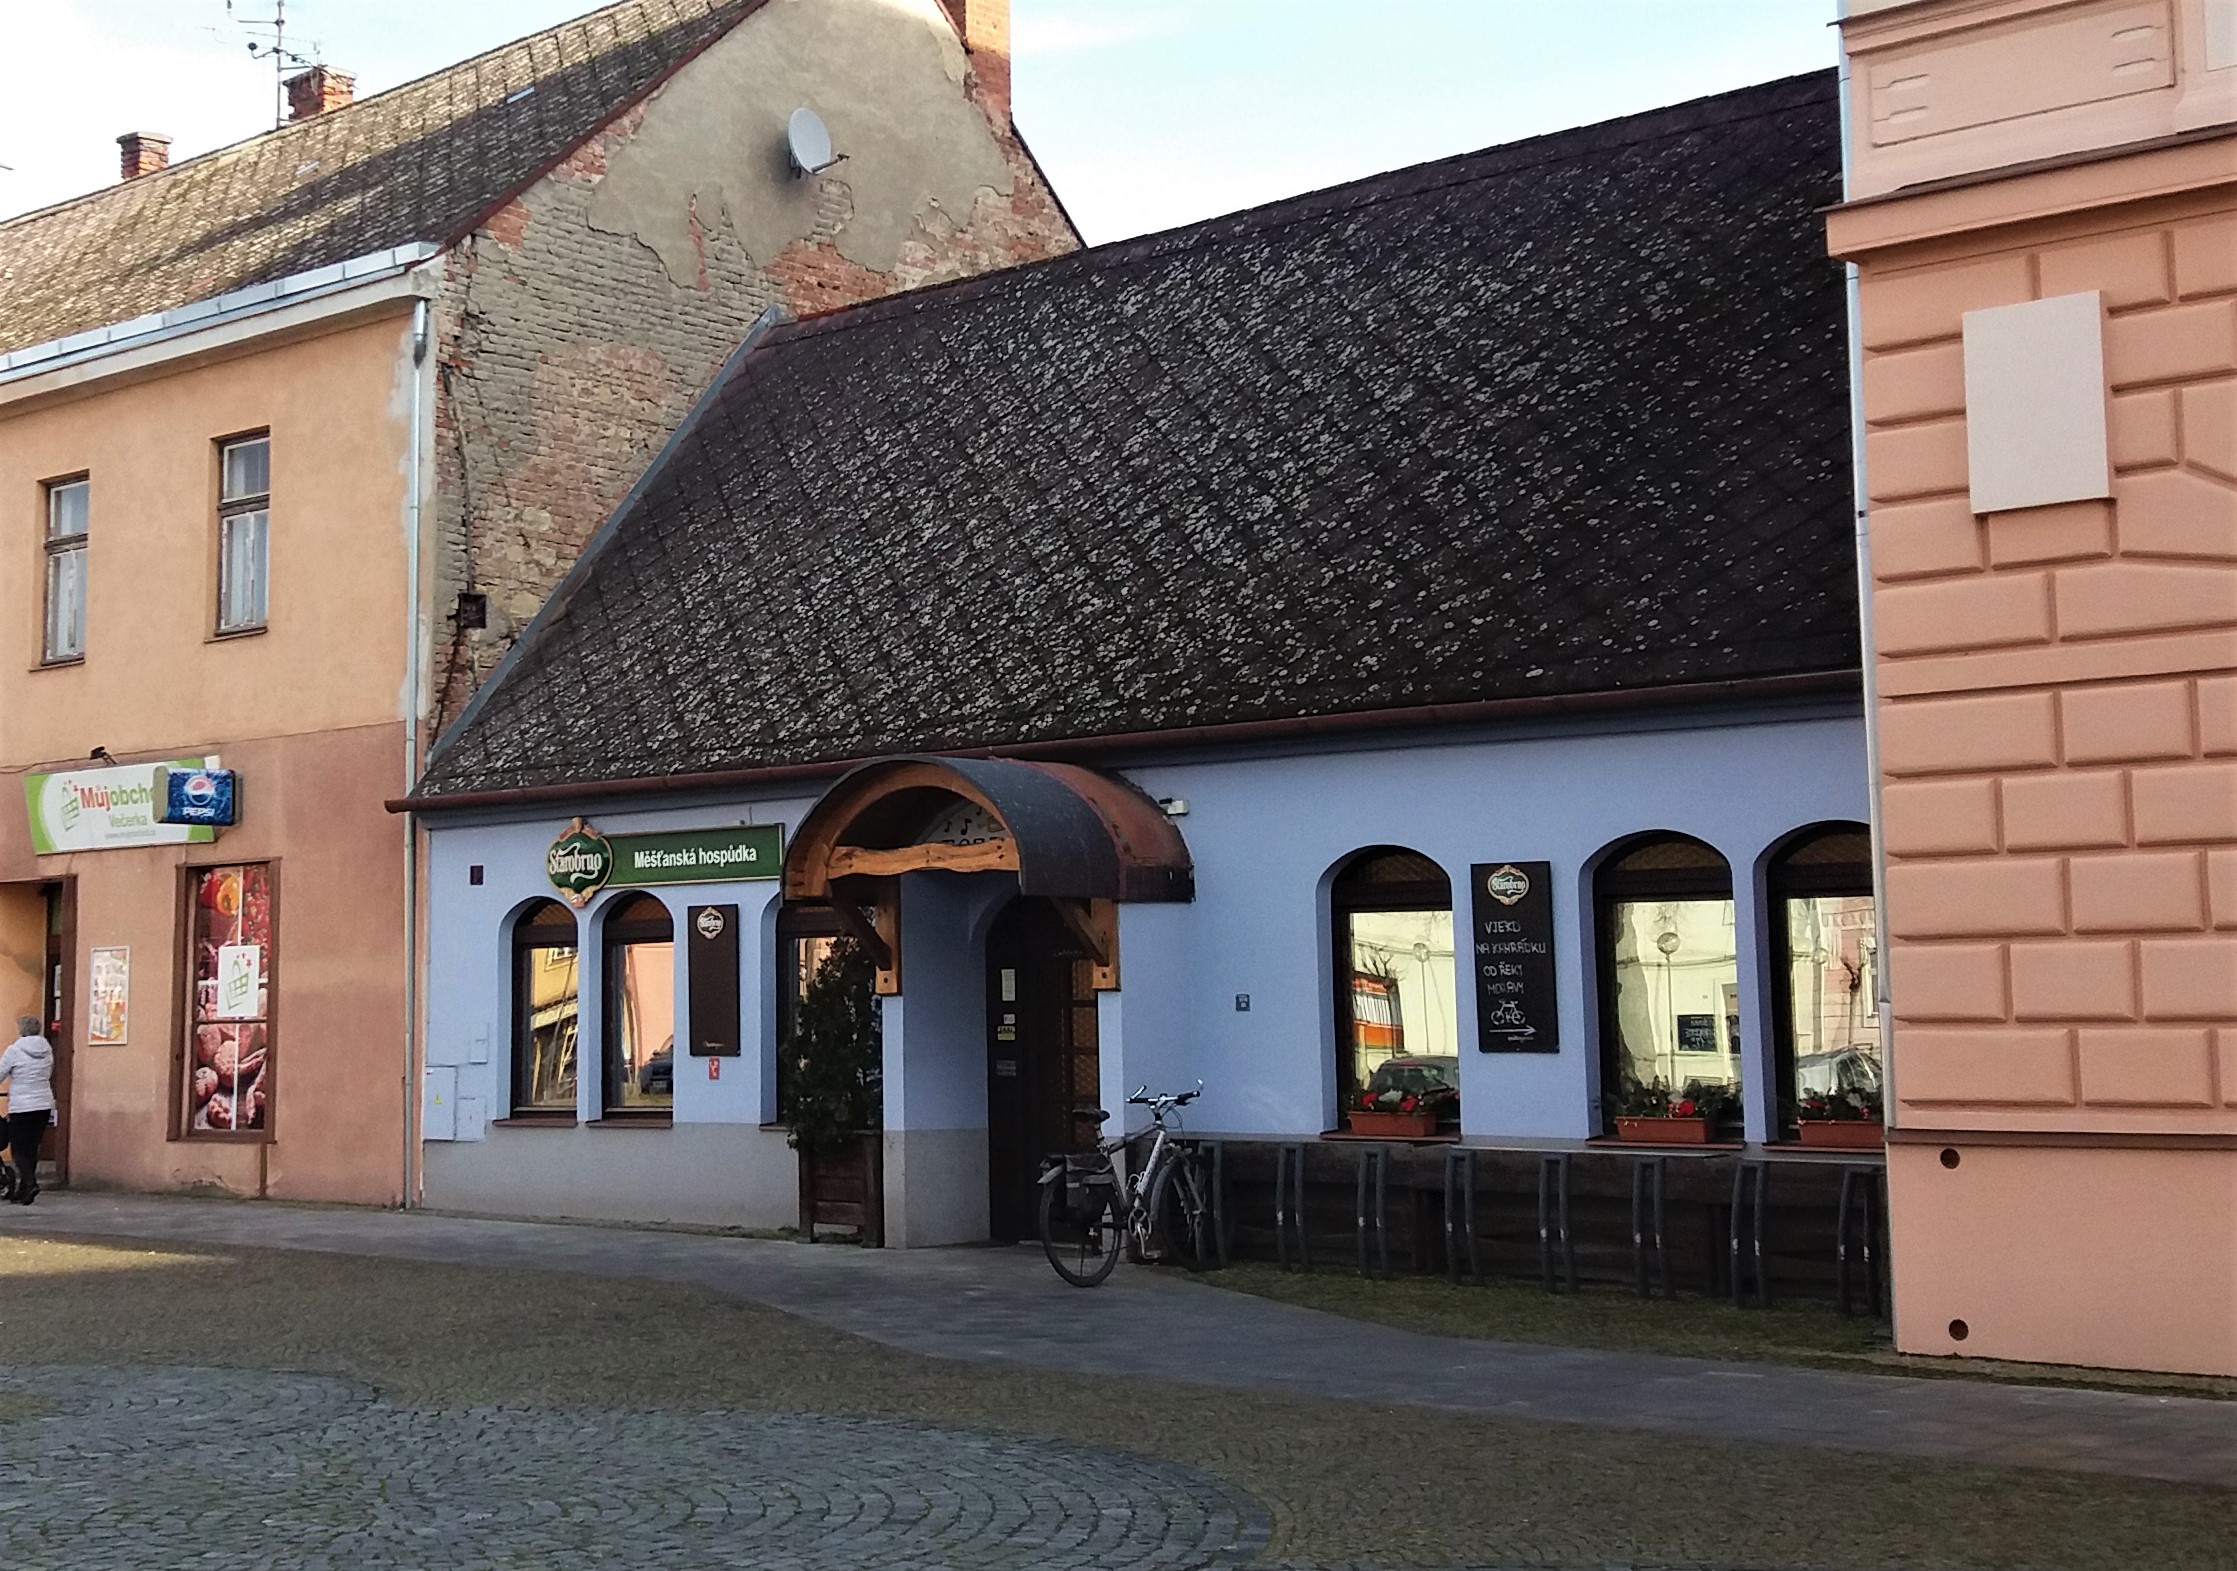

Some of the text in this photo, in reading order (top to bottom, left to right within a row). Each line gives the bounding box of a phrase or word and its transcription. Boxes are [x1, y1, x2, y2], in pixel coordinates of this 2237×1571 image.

[80, 782, 154, 812] Můjobch
[181, 806, 216, 819] PEPSI
[634, 844, 757, 869] Měšťanská hospůdka
[1483, 965, 1498, 977] OD
